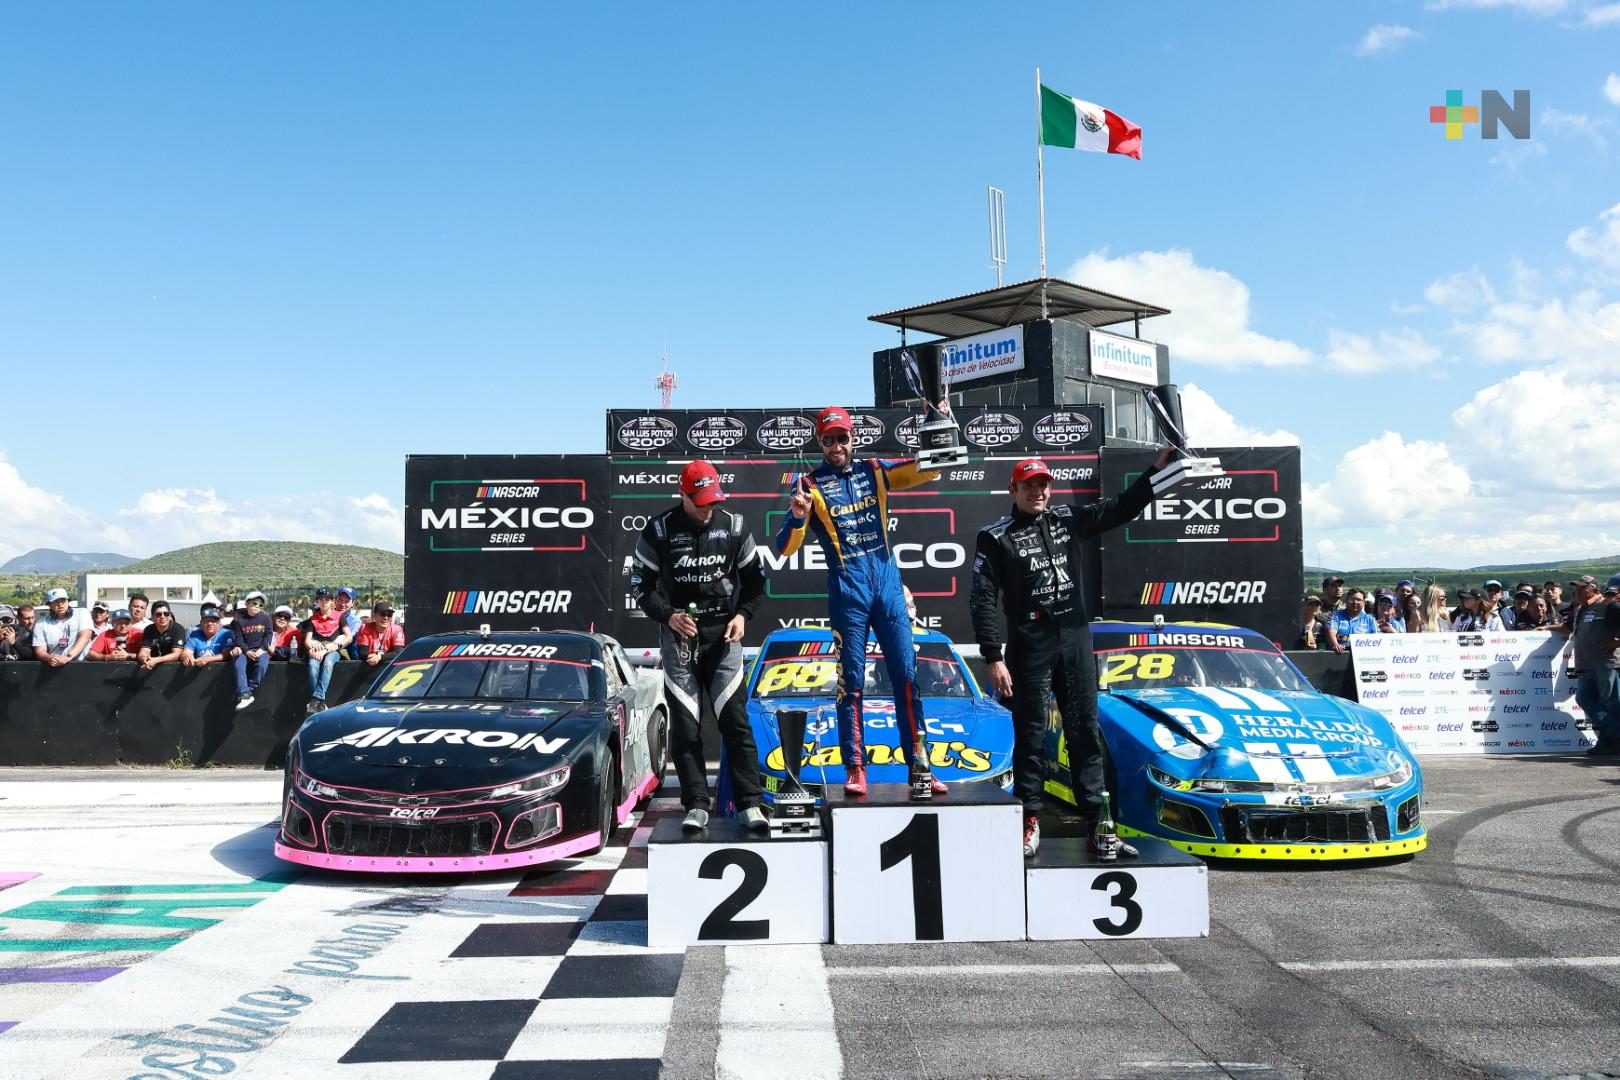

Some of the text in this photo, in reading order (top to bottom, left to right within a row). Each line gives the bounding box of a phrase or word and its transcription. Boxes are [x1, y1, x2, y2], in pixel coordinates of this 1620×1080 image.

[1092, 338, 1153, 368] infinitum
[966, 362, 977, 374] de
[978, 354, 1016, 371] Velocidad
[621, 429, 635, 437] SAN
[636, 429, 650, 437] LUIS
[691, 429, 704, 437] SAN
[705, 429, 719, 437] LUIS
[761, 428, 774, 436] SAN
[775, 428, 788, 436] LUIS
[968, 426, 982, 434] SAN
[983, 426, 995, 434] LUIS
[1036, 425, 1051, 433] SAN
[1052, 425, 1064, 433] LUIS
[629, 438, 666, 447] 200
[698, 438, 735, 447] 200
[768, 438, 804, 446] 200
[975, 434, 1012, 444] 200
[1045, 433, 1081, 443] 200
[619, 471, 683, 484] MÉXIC
[950, 471, 985, 481] SERIES
[491, 486, 540, 498] NASCAR
[421, 501, 594, 530] MÉXICO
[1184, 524, 1220, 535] SERIES
[489, 533, 525, 544] SERIES
[673, 554, 727, 569] AKRON
[674, 571, 712, 583] volaris
[1171, 581, 1267, 605] NASCAR
[474, 590, 572, 614] NASCAR
[778, 617, 831, 629] VICT
[1157, 633, 1245, 649] NASCAR
[1355, 638, 1382, 647] telcel
[460, 644, 558, 659] NASCAR
[1392, 654, 1419, 664] telcel
[1494, 653, 1521, 662] telcel
[1098, 653, 1177, 685] 28
[381, 663, 434, 693] 6
[756, 661, 839, 693] 88
[1428, 671, 1455, 680] telcel
[1531, 670, 1558, 680] telcel
[1362, 690, 1389, 699] telcel
[1400, 706, 1427, 715] telcel
[1503, 704, 1530, 713] telcel
[1230, 714, 1375, 736] HERALDO
[1436, 722, 1464, 732] telcel
[1540, 721, 1568, 731] telcel
[308, 726, 571, 754] AKRON
[1239, 727, 1383, 748] MEDIA GROUP
[1578, 738, 1597, 748] telc
[389, 807, 441, 819] telcel
[880, 813, 944, 941] 1
[696, 847, 771, 941] 2
[1090, 871, 1143, 937] 3
